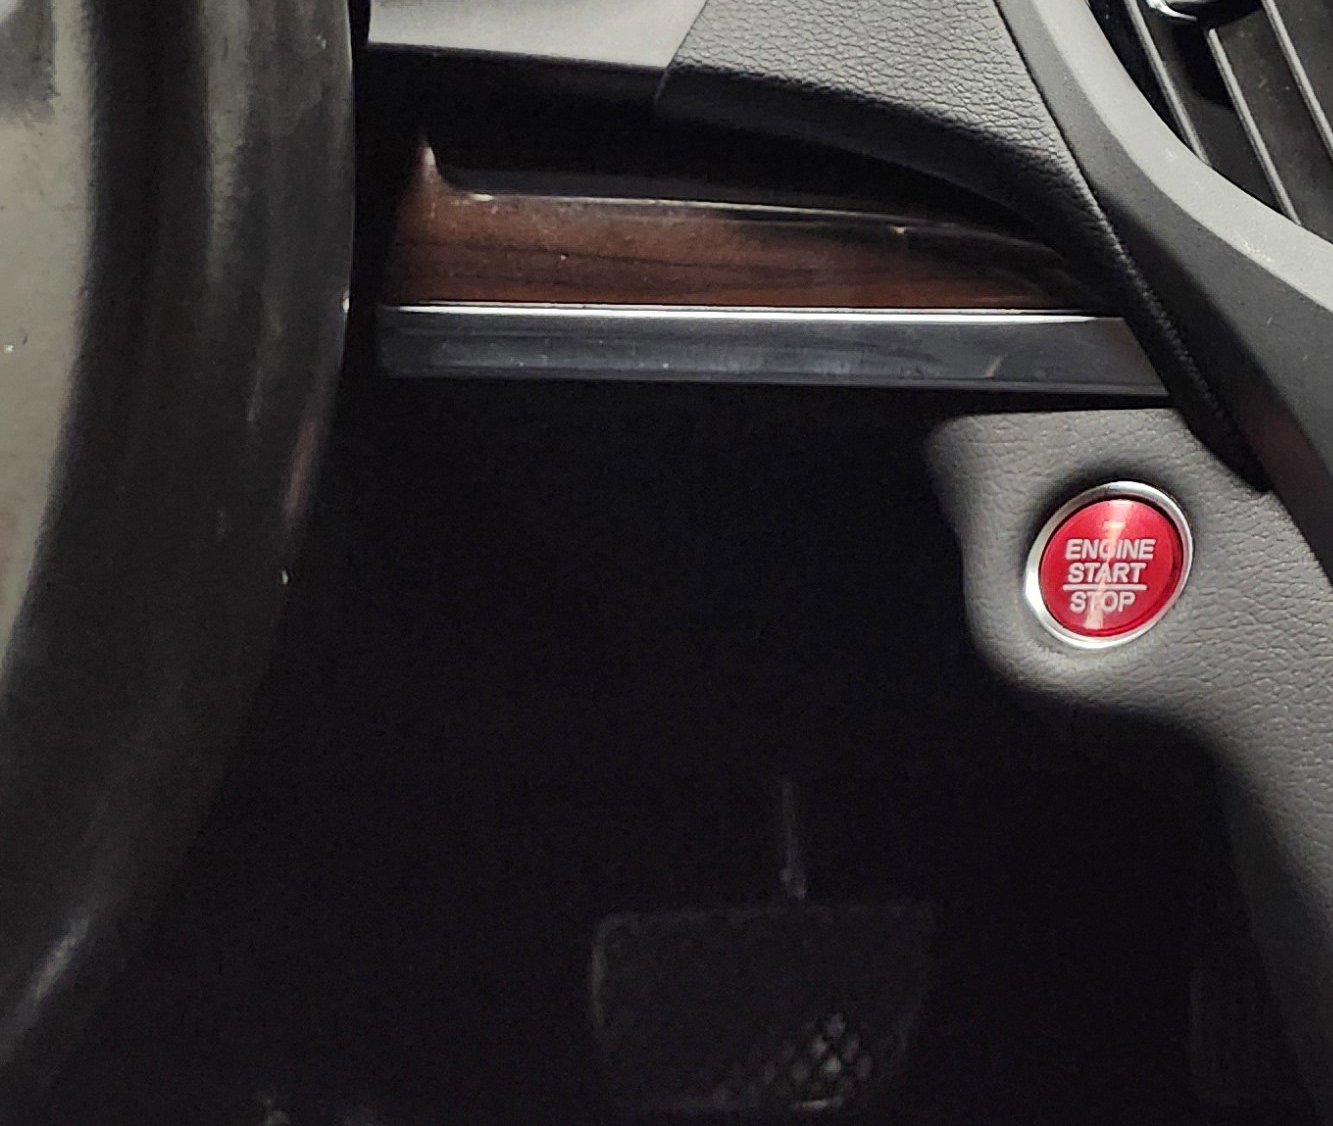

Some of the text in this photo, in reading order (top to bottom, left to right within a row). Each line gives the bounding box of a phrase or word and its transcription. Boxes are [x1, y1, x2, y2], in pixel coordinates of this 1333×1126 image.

[1065, 538, 1157, 560] ENGINE
[1067, 562, 1146, 583] START
[1070, 591, 1135, 614] STOP
